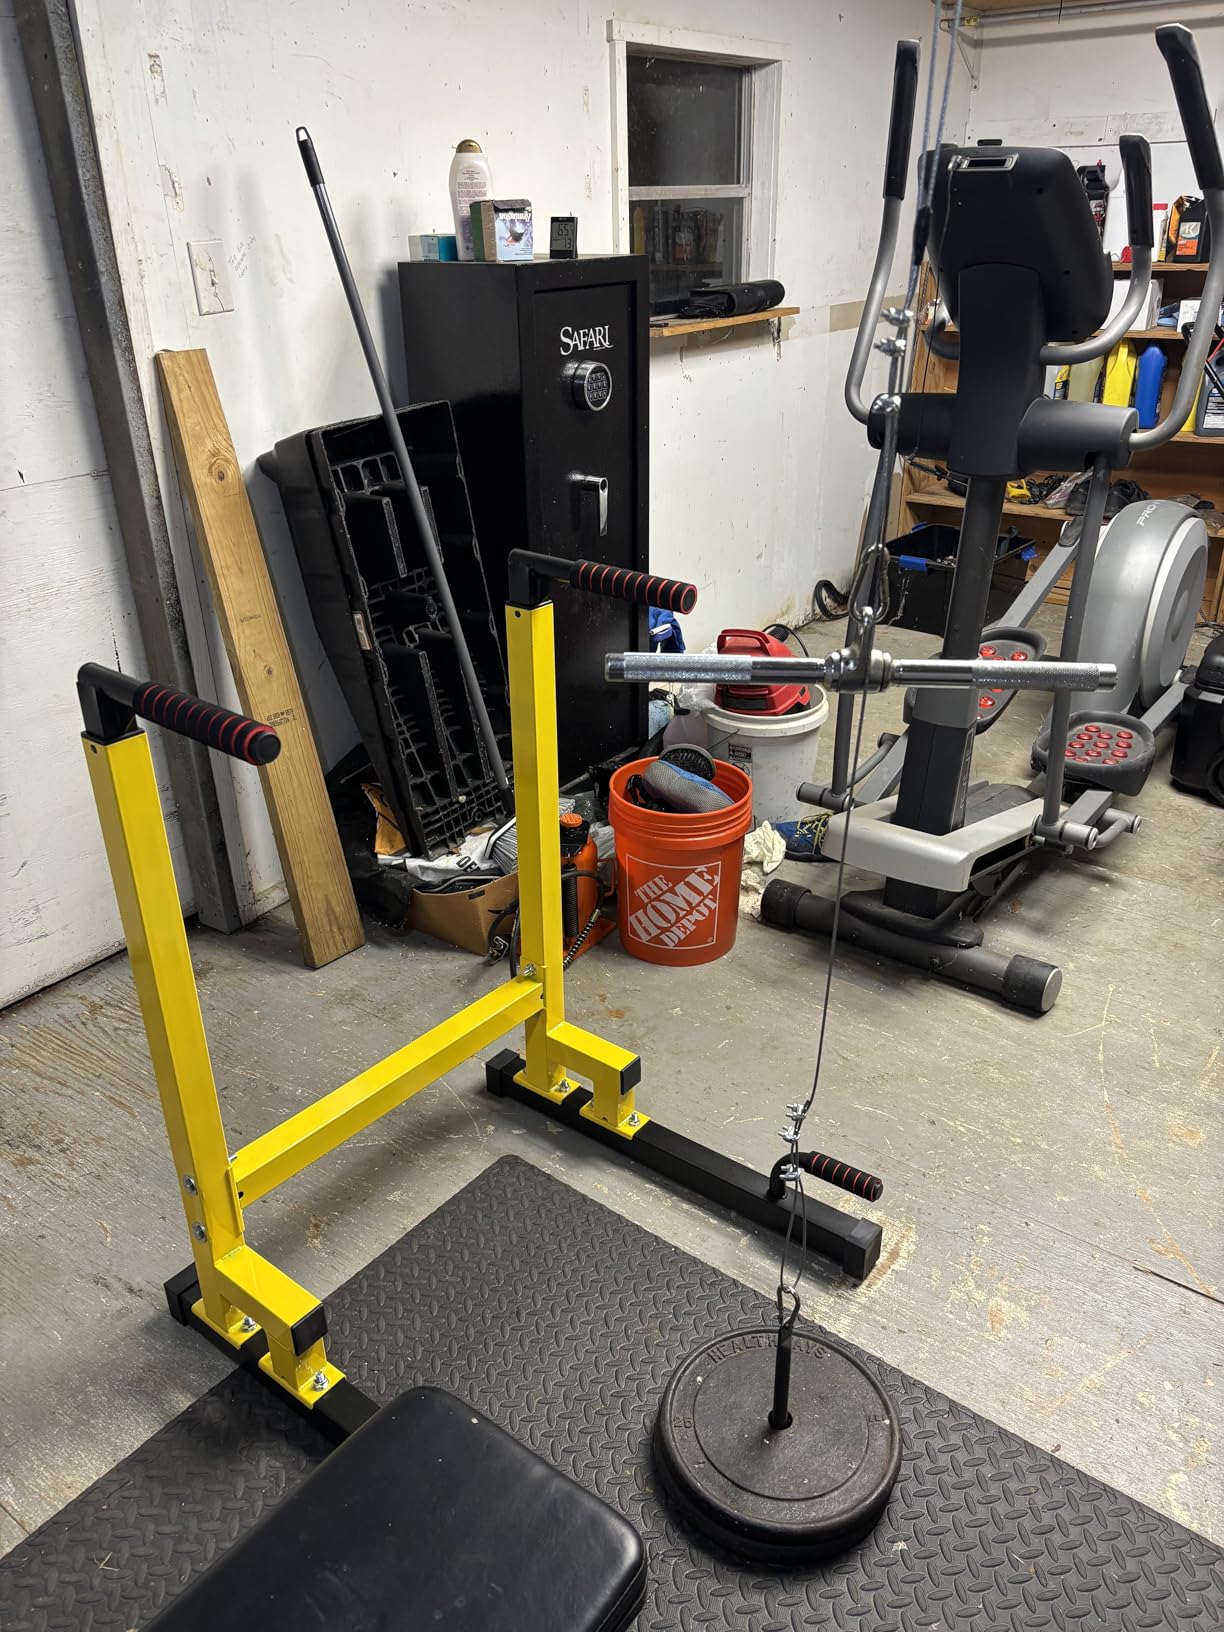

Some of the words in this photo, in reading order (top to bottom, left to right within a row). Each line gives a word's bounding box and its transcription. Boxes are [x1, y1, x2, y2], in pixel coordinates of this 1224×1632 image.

[558, 224, 569, 236] 65
[563, 237, 572, 249] 73
[560, 325, 614, 356] SAFARI
[629, 866, 720, 942] HOME
[634, 874, 672, 904] THE
[659, 895, 717, 947] DEPOT
[706, 1333, 828, 1364] HEALTHAYS
[673, 1416, 692, 1429] 25
